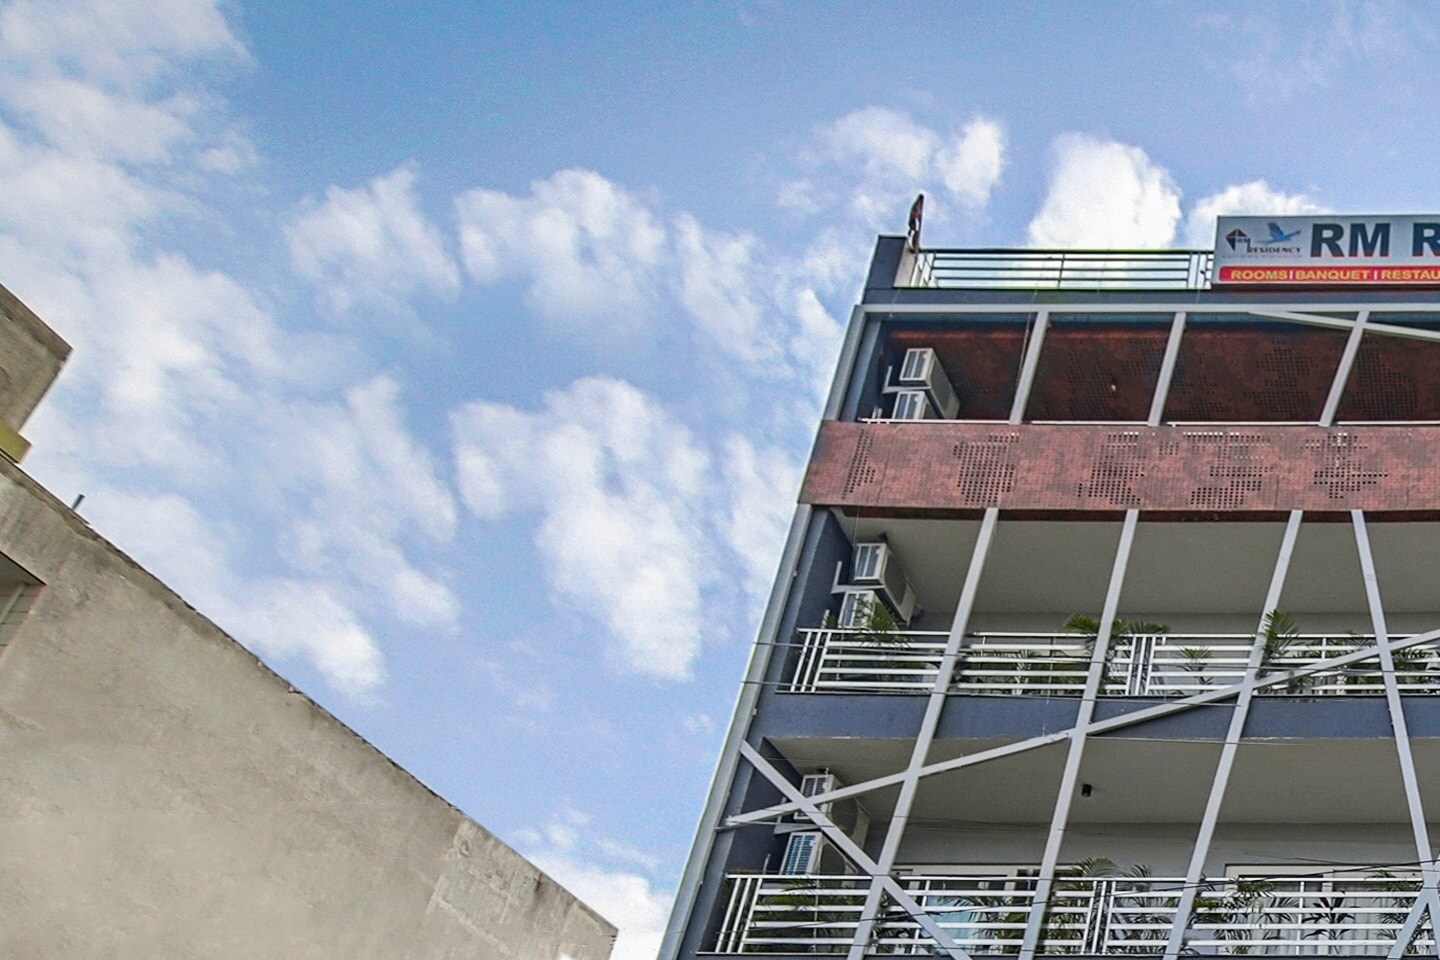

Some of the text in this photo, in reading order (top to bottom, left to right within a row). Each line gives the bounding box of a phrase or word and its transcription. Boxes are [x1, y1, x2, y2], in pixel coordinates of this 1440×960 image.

[1310, 223, 1390, 257] RM
[1247, 246, 1302, 254] RESIDENCY
[1231, 270, 1288, 280] ROOMS
[1295, 269, 1368, 280] BANQUET
